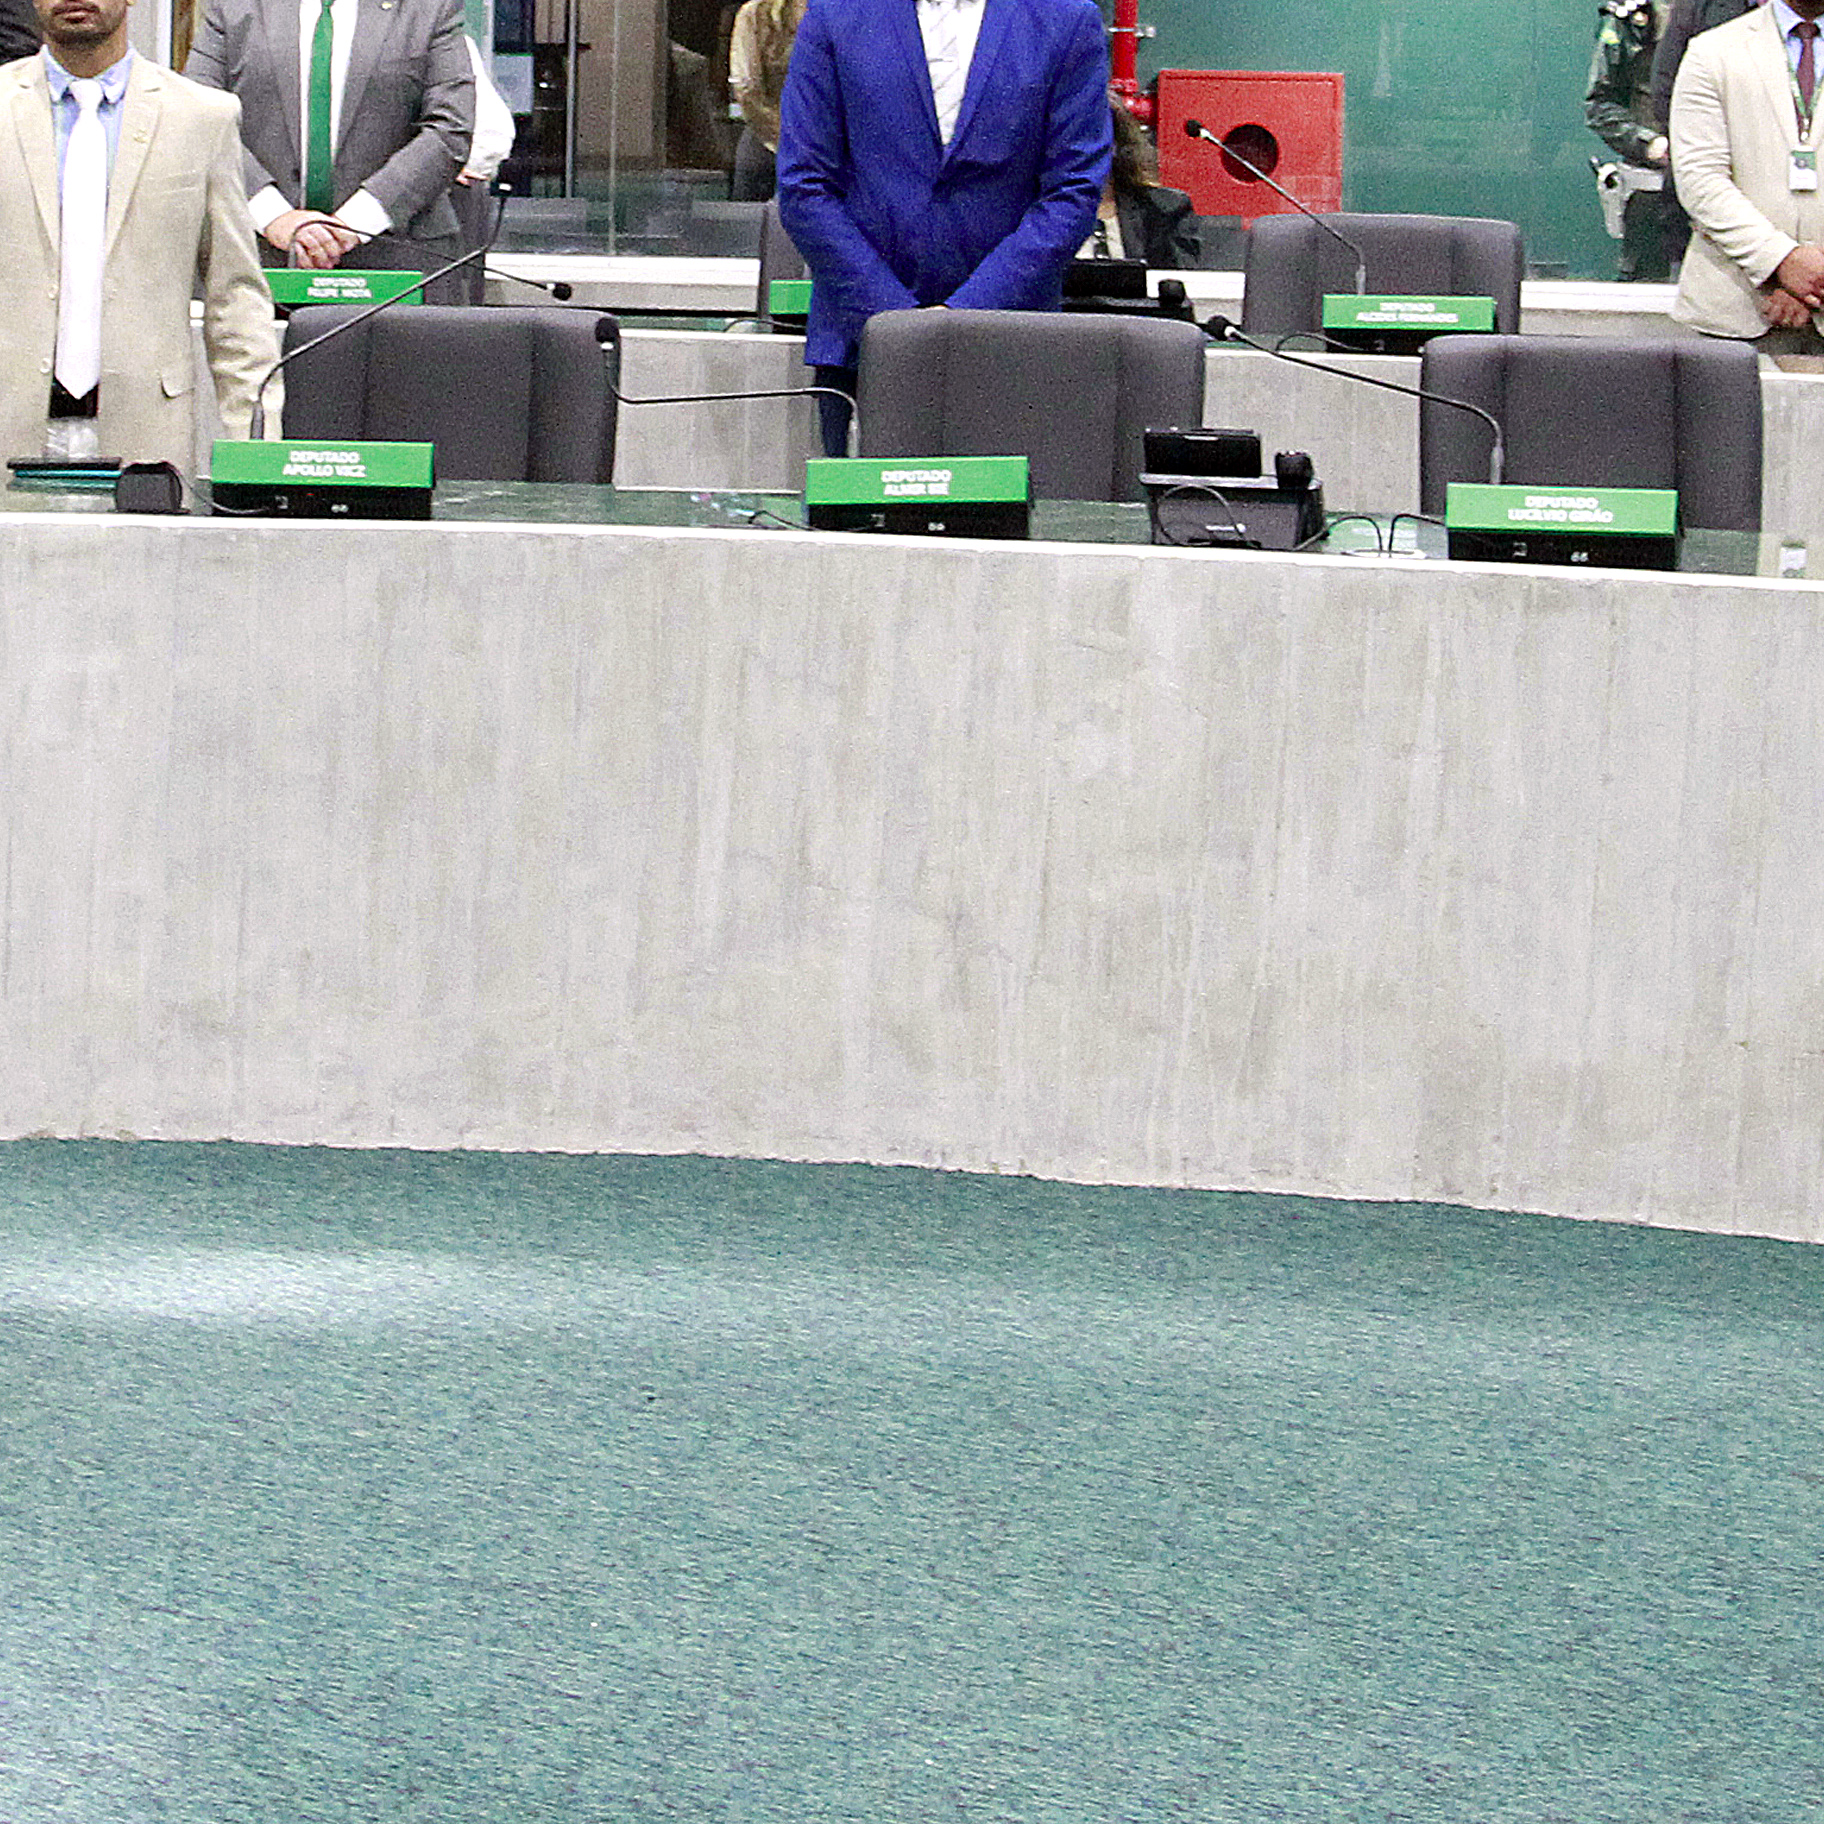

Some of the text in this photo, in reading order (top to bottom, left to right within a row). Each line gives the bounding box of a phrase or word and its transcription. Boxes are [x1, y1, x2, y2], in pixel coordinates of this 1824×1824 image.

[289, 450, 361, 464] DEPUTADO
[881, 469, 952, 483] DEPUTADO
[1524, 495, 1600, 510] DEPUTADO
